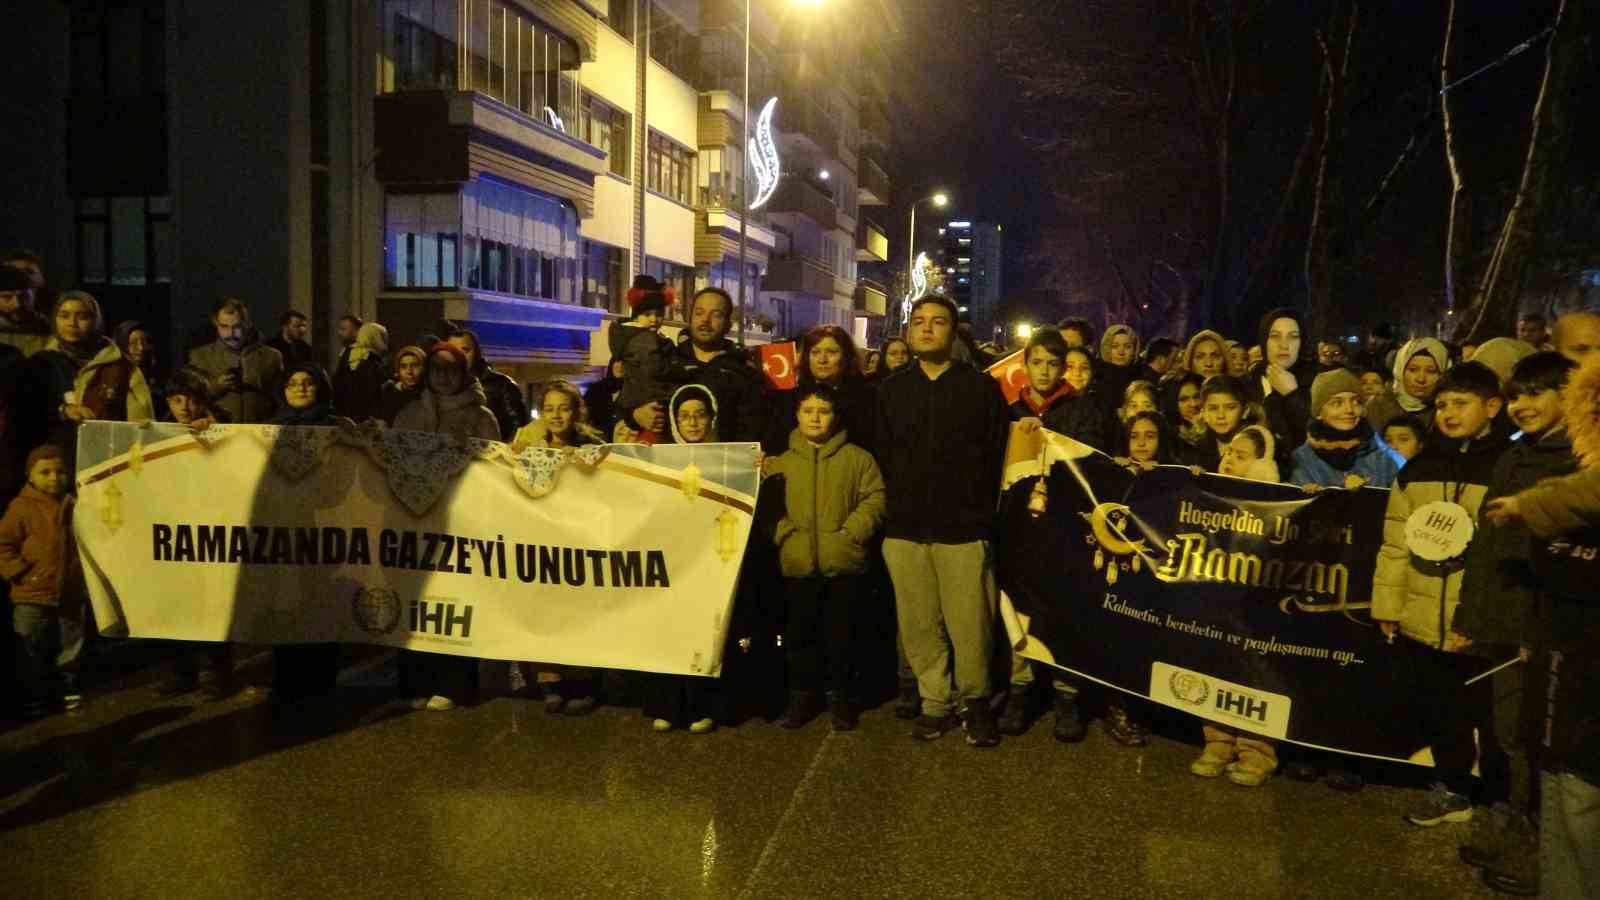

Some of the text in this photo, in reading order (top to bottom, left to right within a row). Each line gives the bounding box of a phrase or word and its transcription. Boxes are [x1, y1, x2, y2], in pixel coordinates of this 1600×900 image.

[1179, 501, 1264, 536] Hoşgeldin
[153, 523, 371, 566] RAMAZANDA
[515, 543, 670, 588] UNUTMA
[1156, 533, 1349, 613] Ramazan
[1166, 614, 1223, 641] bereketin
[1226, 633, 1241, 645] ve
[1243, 636, 1329, 659] paylaşmanın
